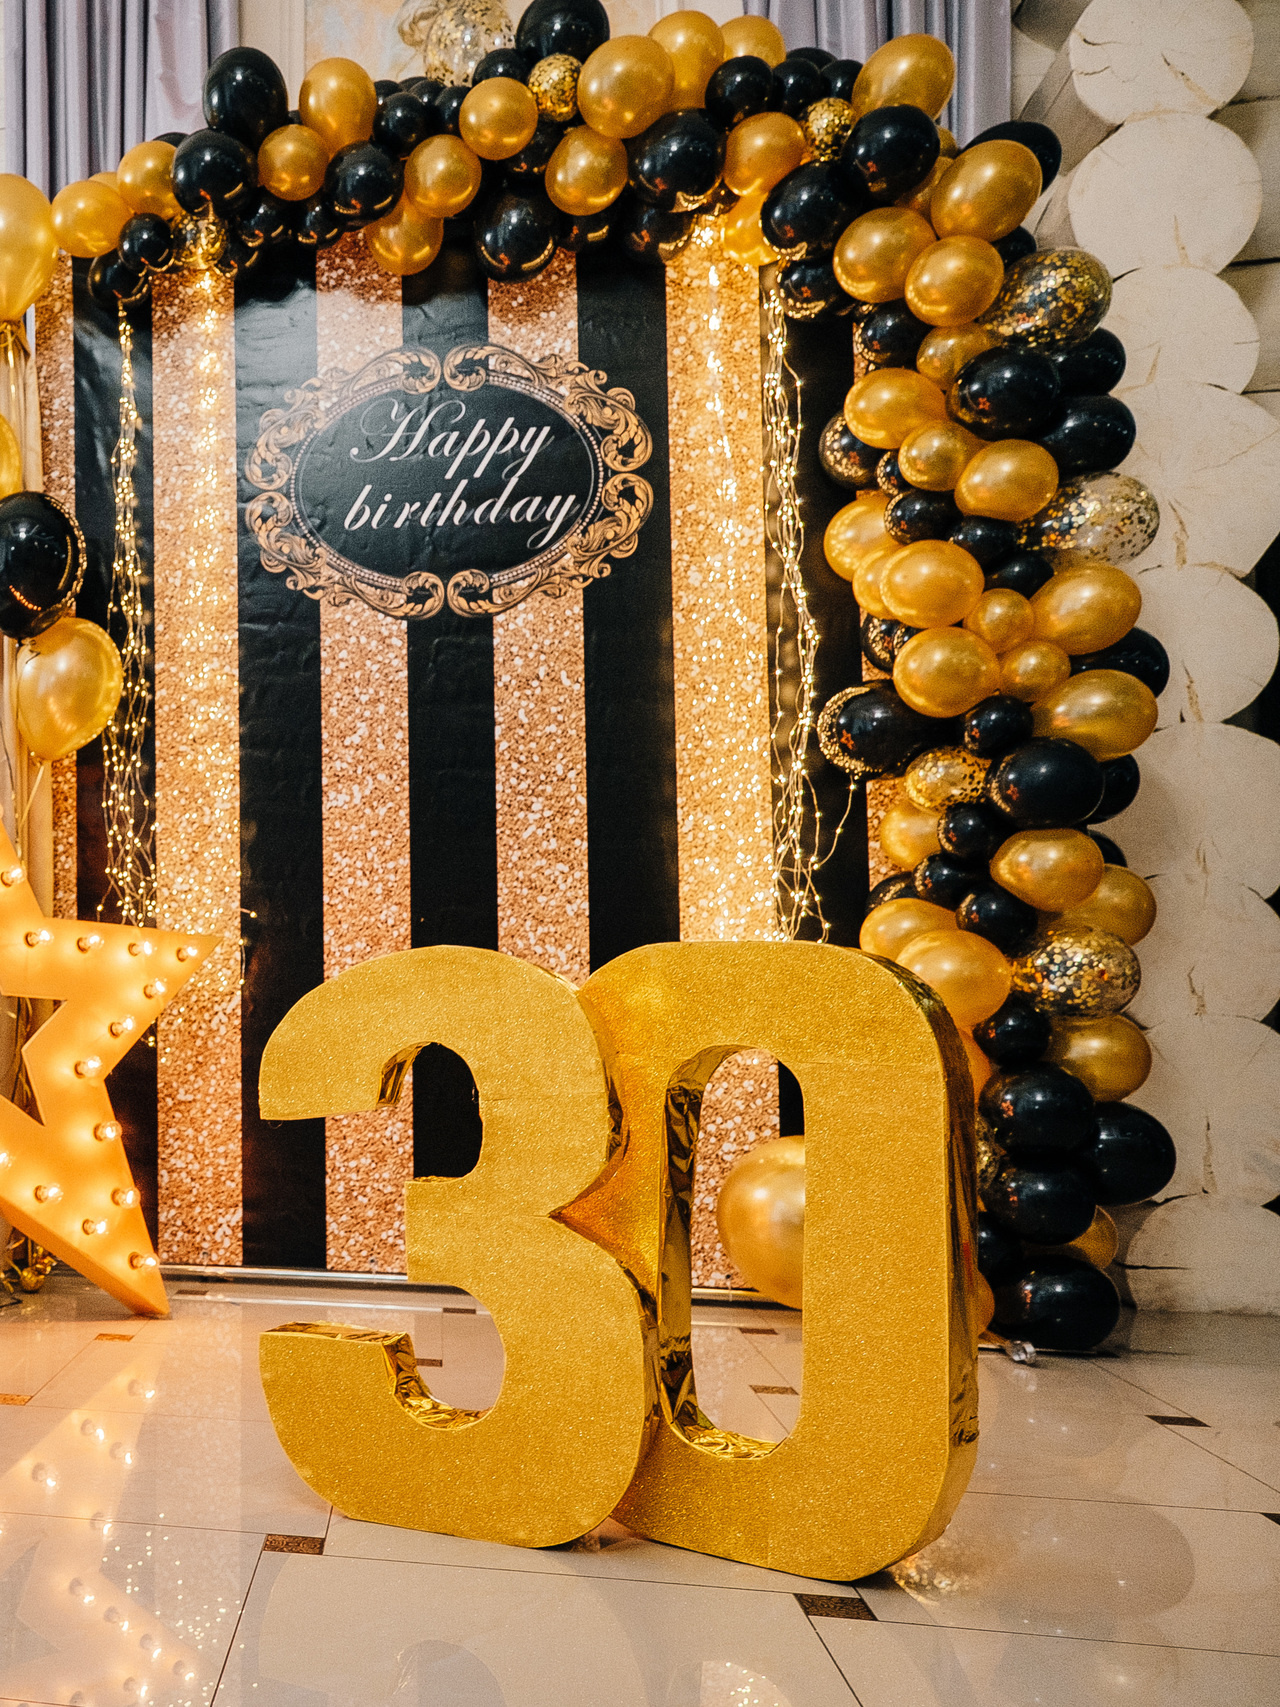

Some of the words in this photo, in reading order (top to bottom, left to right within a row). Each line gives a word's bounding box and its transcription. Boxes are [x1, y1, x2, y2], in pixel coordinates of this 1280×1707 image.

[350, 399, 555, 480] Happy
[344, 478, 580, 550] birthday
[259, 941, 979, 1582] 30
